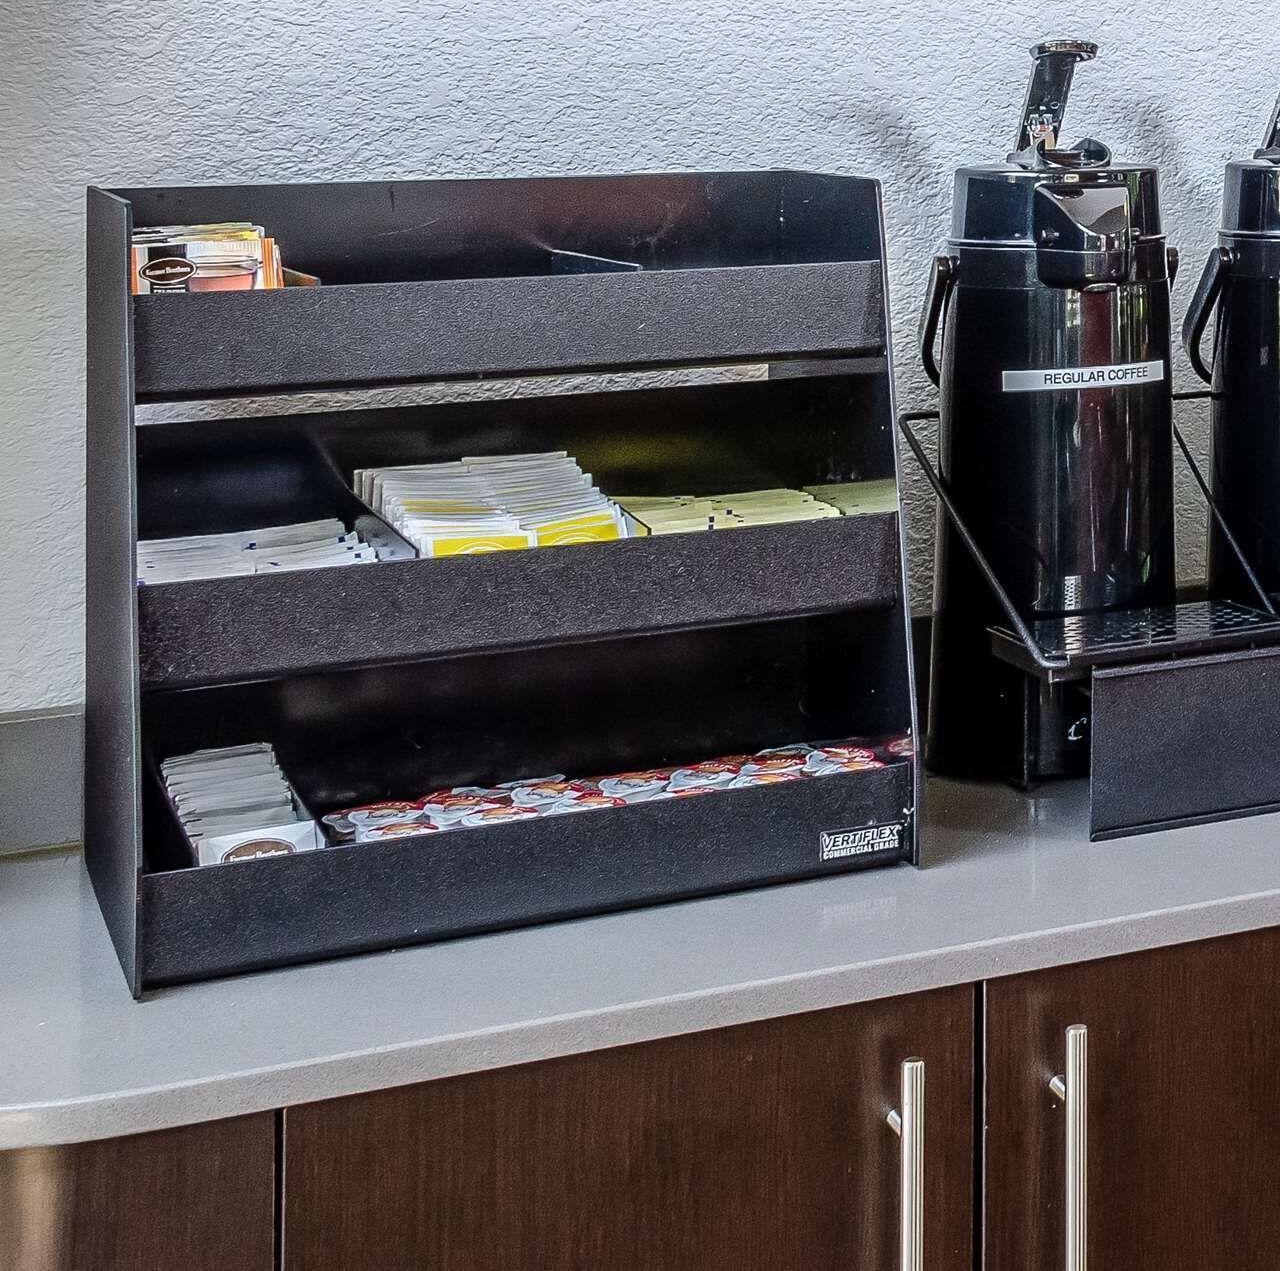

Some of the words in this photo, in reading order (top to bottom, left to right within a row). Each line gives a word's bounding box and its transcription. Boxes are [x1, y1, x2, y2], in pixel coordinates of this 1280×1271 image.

[1044, 370, 1105, 385] REGULAR
[1107, 366, 1148, 381] COFFEE
[822, 824, 899, 851] VERTIFLEX
[823, 843, 872, 860] COMMERCIAL
[873, 839, 899, 851] GRADE
